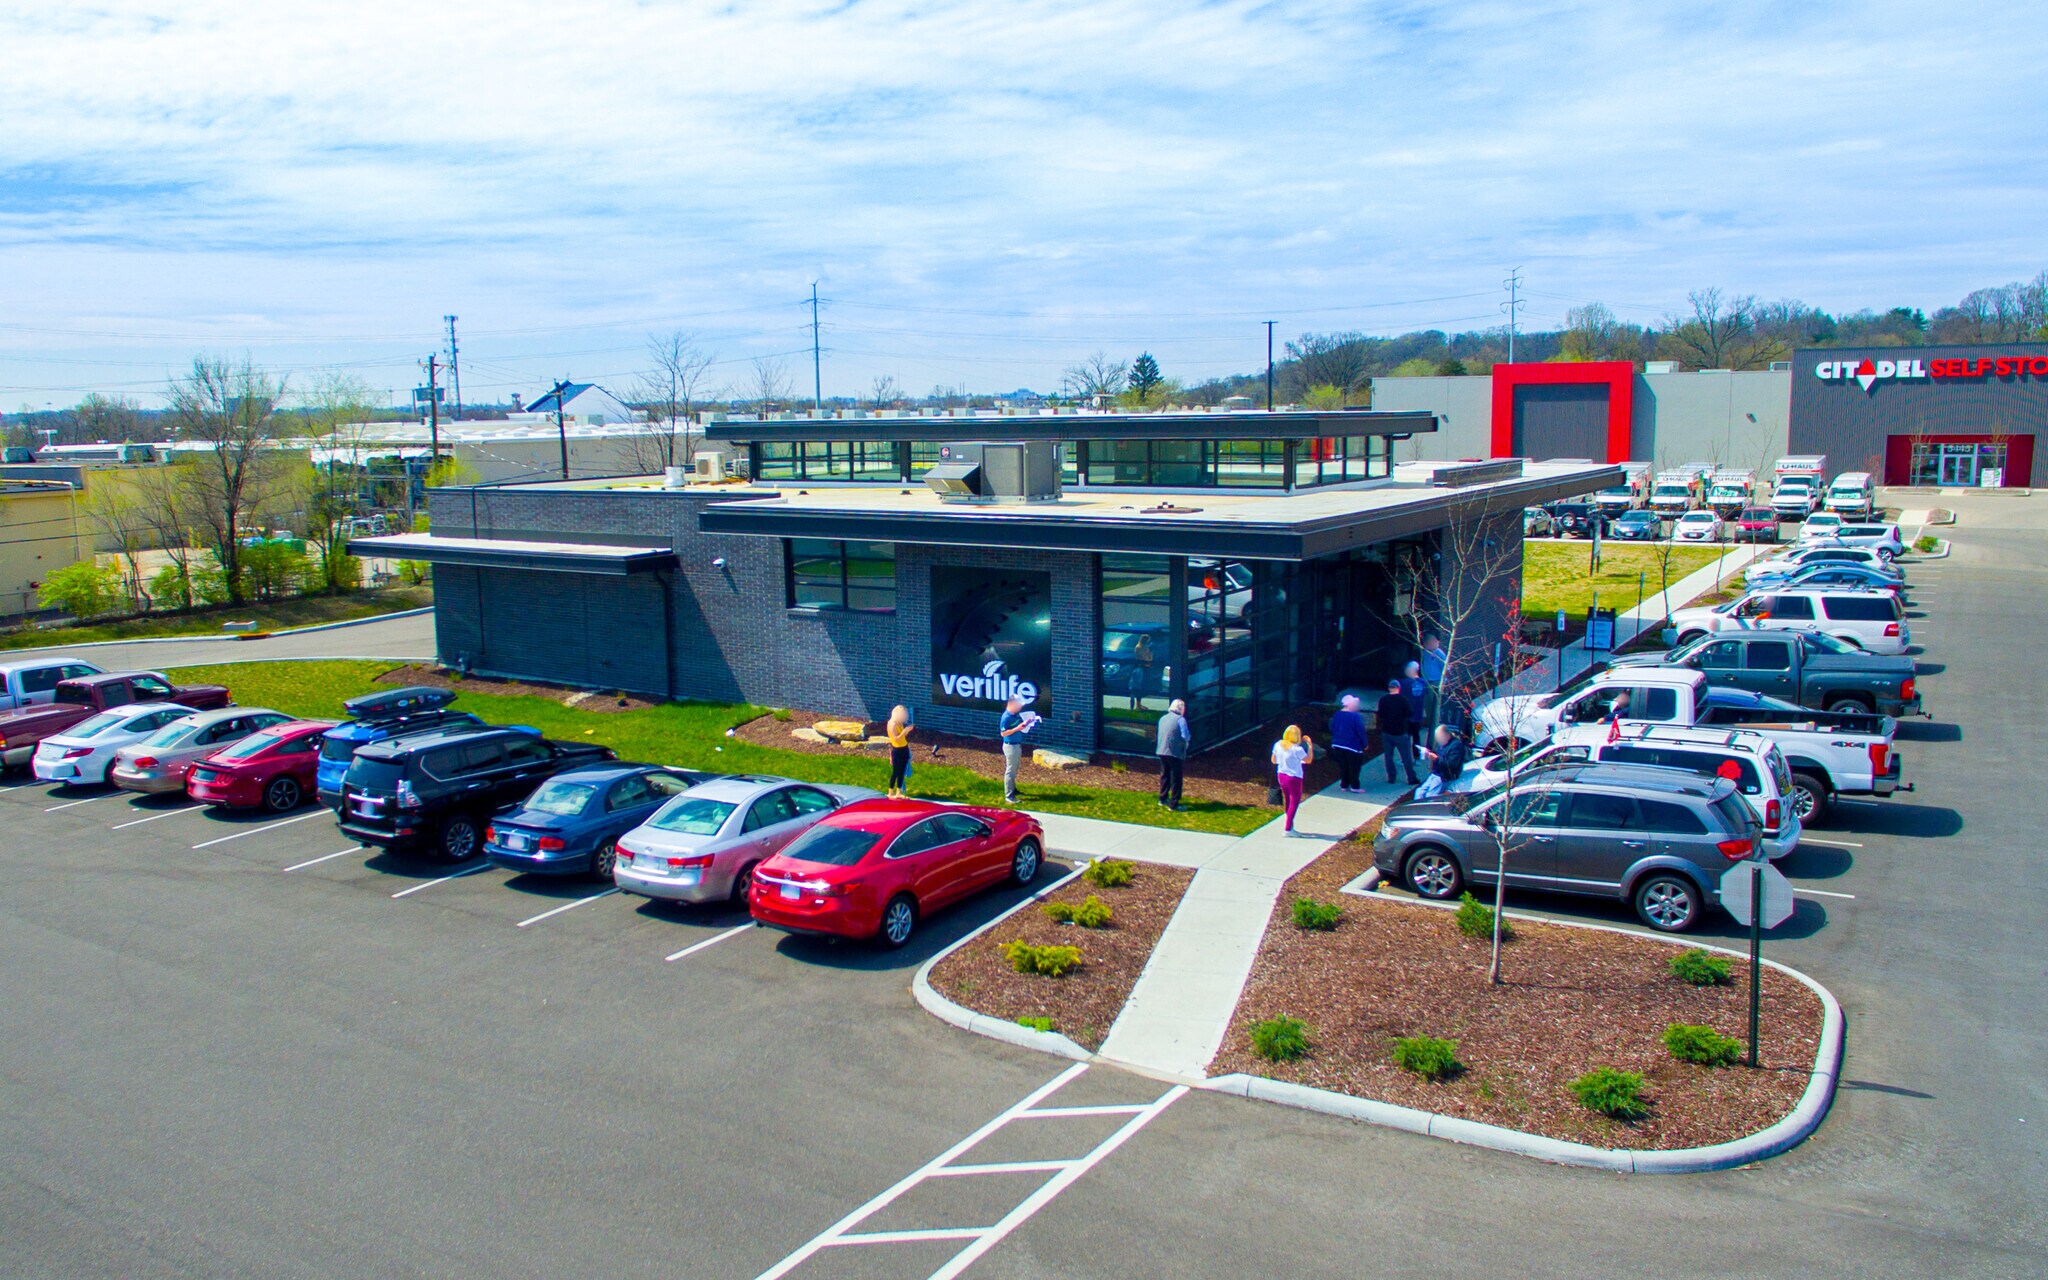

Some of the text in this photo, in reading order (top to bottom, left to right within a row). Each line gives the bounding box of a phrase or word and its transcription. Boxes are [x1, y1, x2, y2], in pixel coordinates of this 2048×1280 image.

[1815, 358, 1926, 391] CITADEL
[1930, 358, 1992, 377] SELF
[939, 672, 1037, 705] verilife
